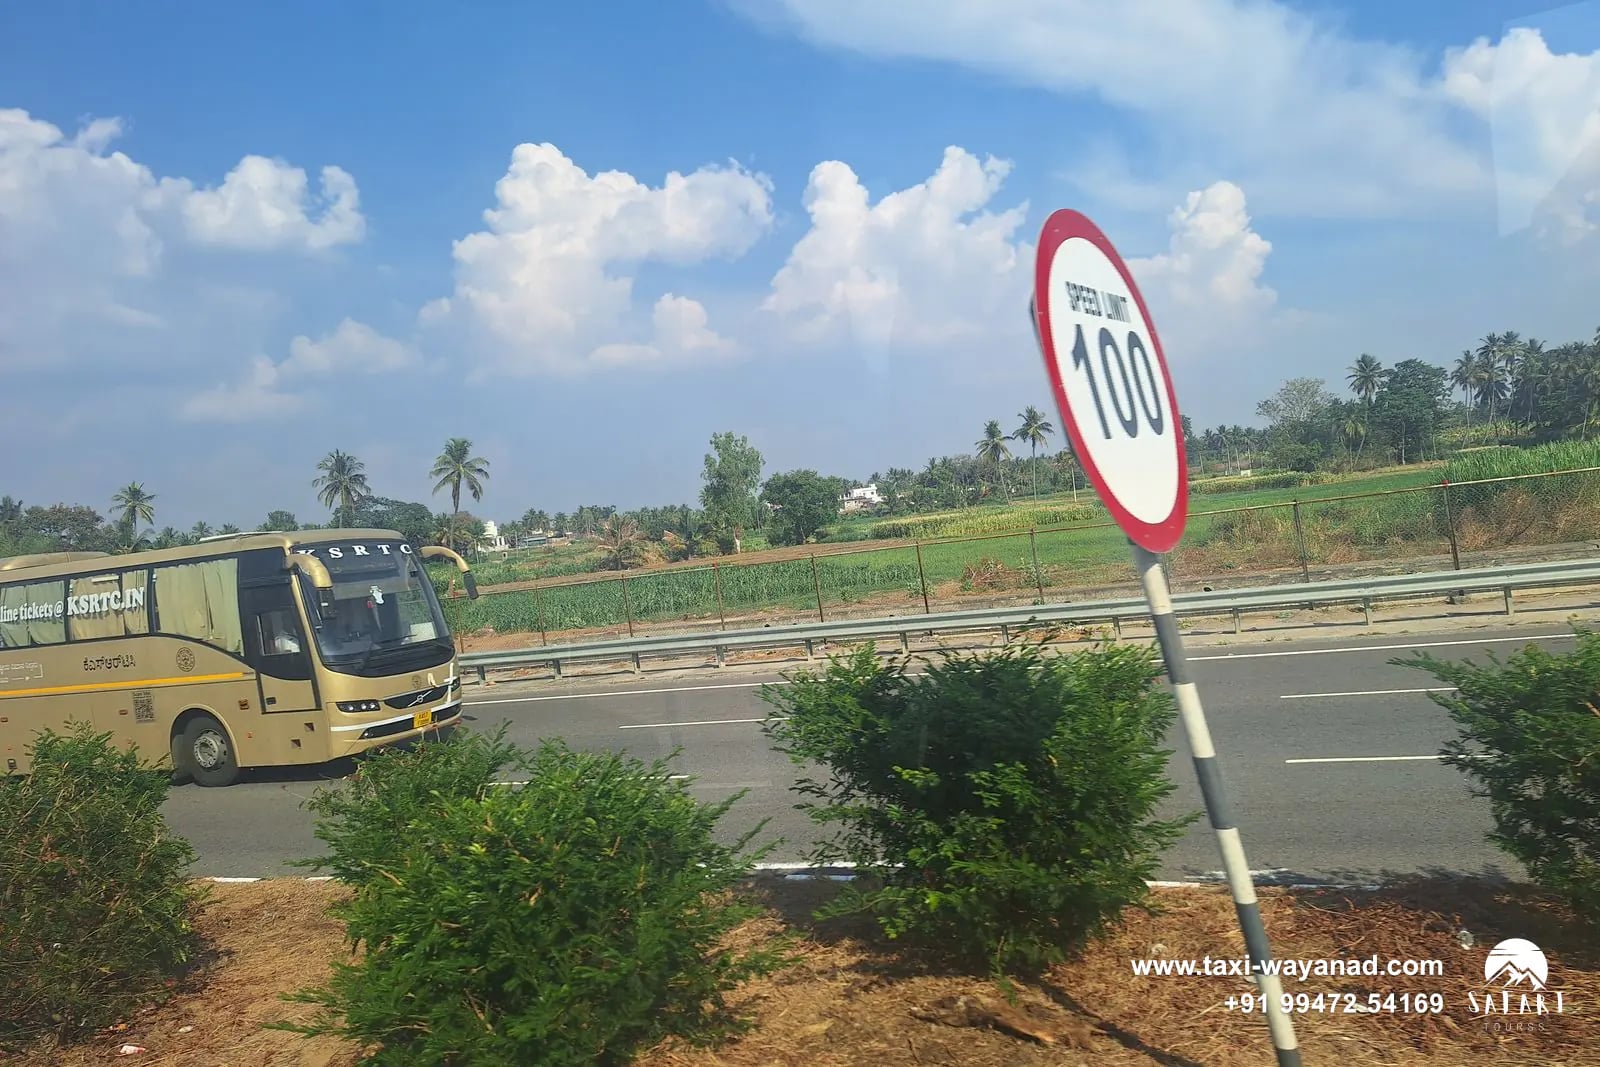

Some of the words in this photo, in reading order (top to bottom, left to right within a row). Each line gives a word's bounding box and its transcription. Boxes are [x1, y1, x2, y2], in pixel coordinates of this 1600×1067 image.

[1065, 281, 1102, 317] SPEED
[1100, 291, 1131, 323] LIMIT
[1071, 323, 1163, 440] 100
[67, 586, 145, 616] KSRTC.IN
